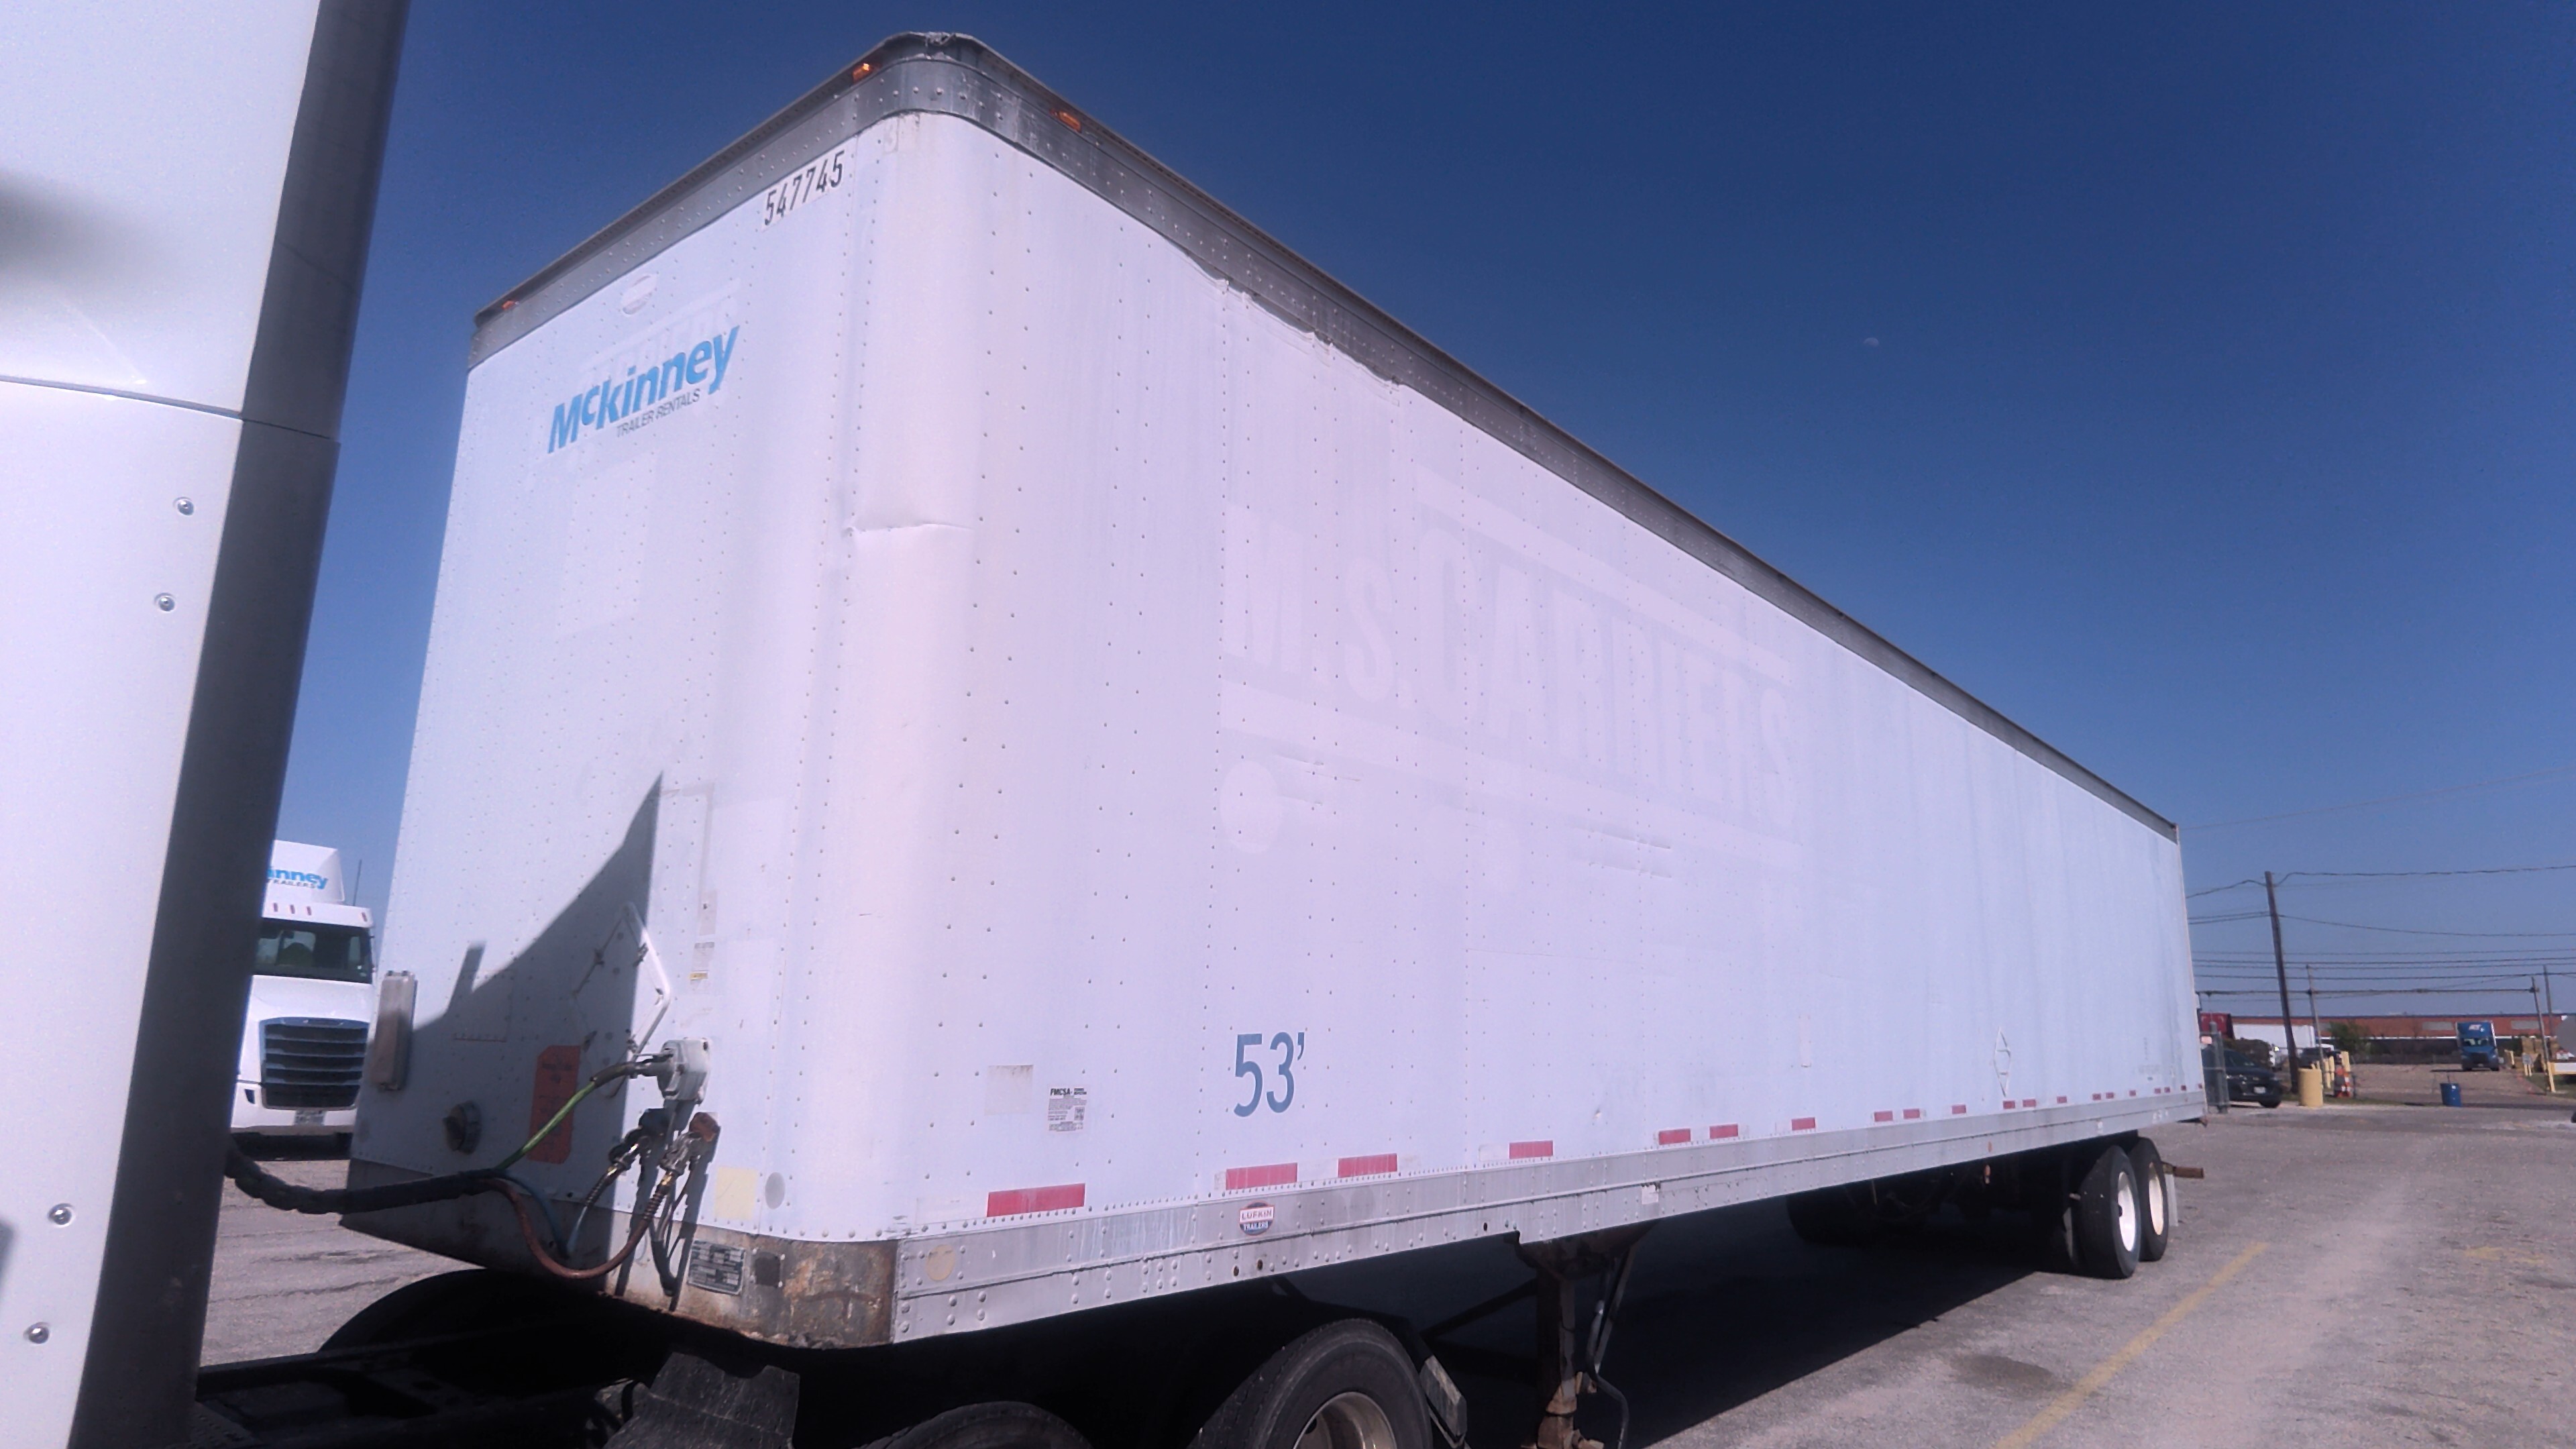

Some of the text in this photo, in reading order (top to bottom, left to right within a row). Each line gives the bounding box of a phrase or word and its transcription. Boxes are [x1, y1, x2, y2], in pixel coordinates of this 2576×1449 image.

[765, 150, 845, 225] 547745
[616, 388, 700, 437] TRAILER RENTALS
[267, 867, 329, 890] inney
[1234, 1032, 1305, 1117] 53'
[1242, 1210, 1272, 1220] LUFKIN
